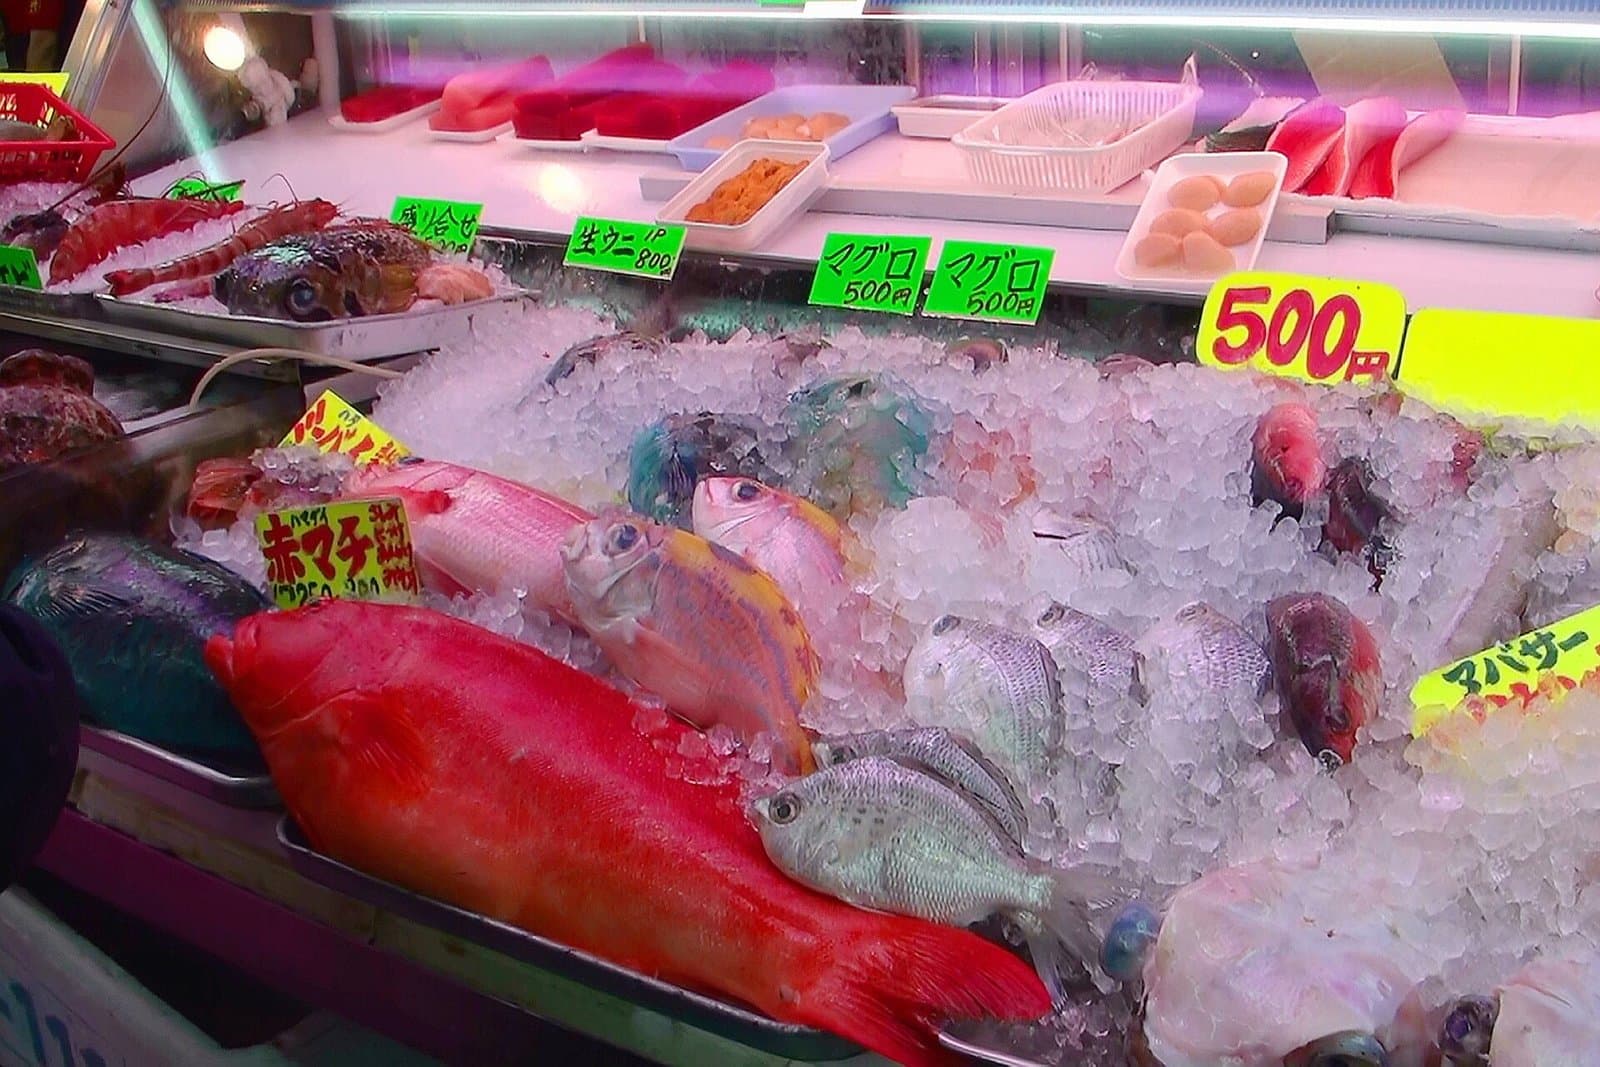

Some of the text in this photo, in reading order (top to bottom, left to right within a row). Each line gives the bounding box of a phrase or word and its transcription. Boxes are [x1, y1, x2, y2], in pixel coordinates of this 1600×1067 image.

[571, 222, 635, 256] 生ウニ
[823, 241, 918, 281] マグロ
[945, 248, 1041, 293] マグロ
[843, 281, 912, 307] 500円
[966, 290, 1036, 317] 500円
[262, 513, 375, 585] 赤マチ
